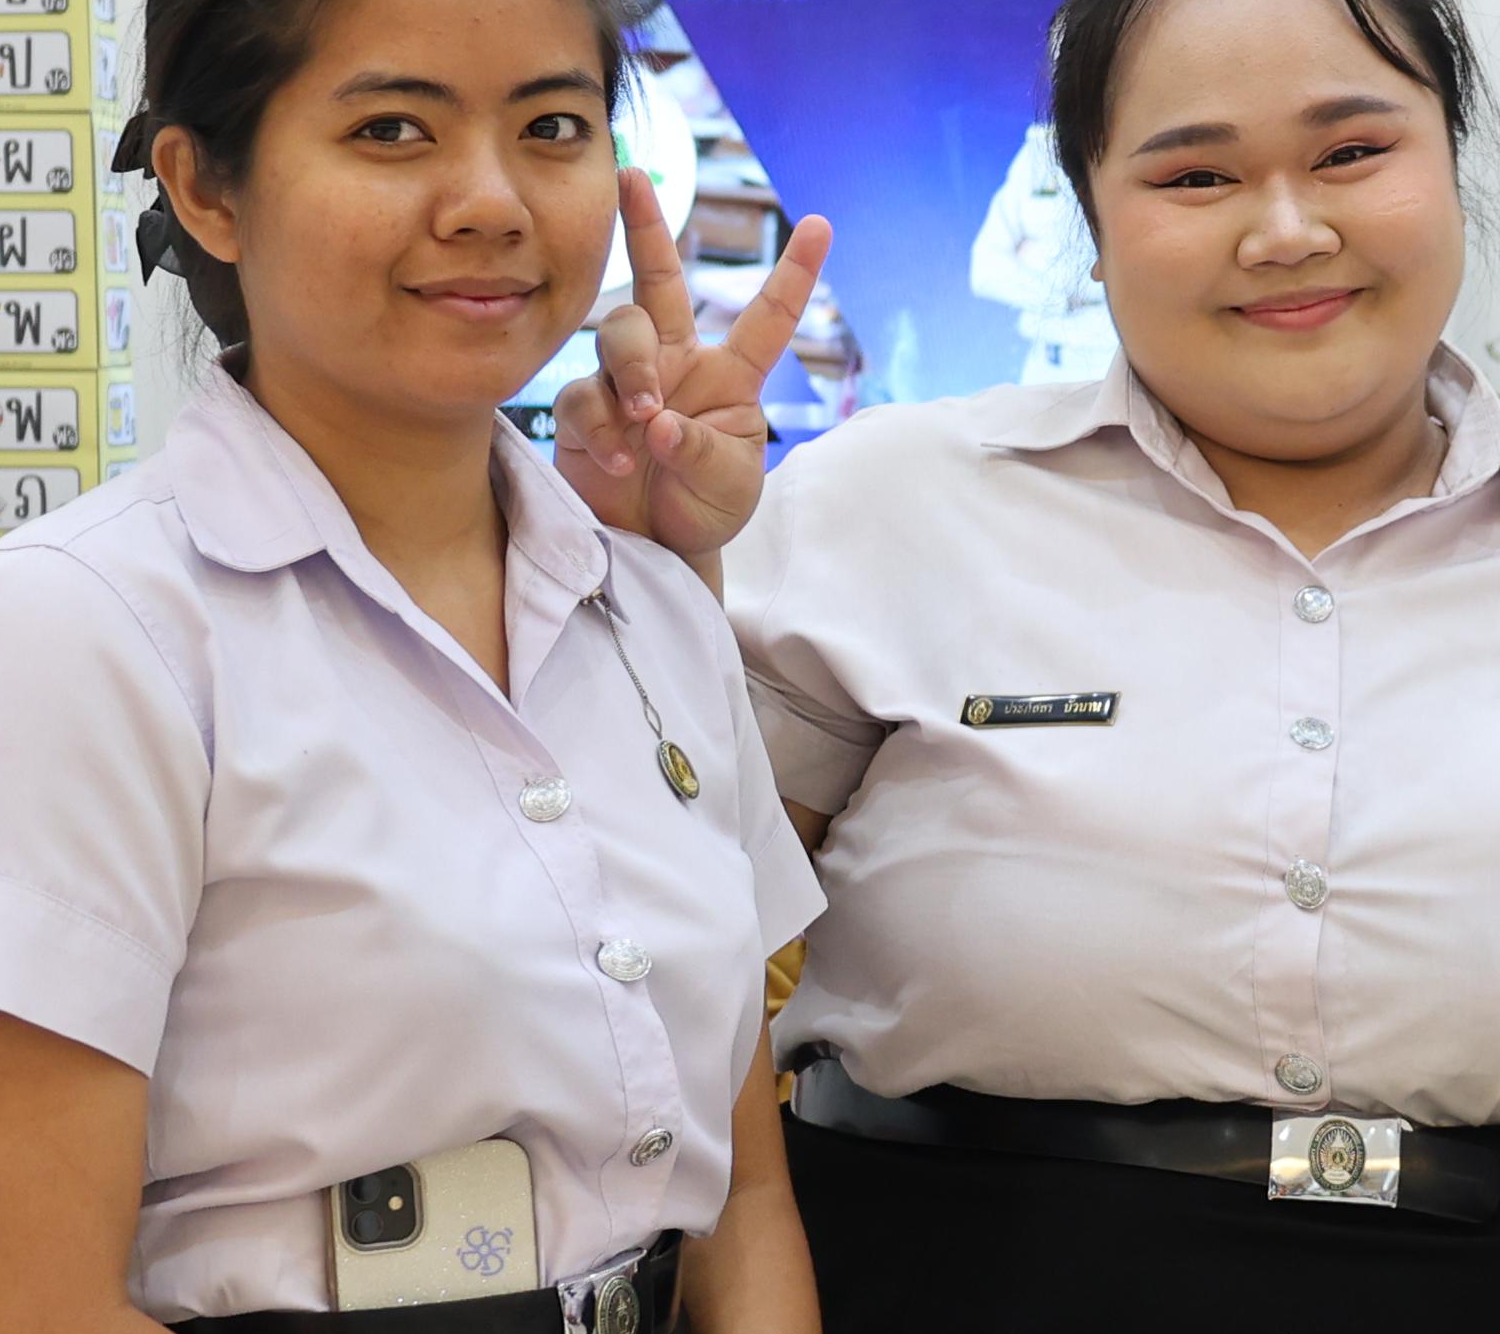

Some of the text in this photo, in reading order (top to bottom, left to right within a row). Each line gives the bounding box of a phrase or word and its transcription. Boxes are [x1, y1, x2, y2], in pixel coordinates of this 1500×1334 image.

[4, 139, 33, 184] ผ
[4, 301, 41, 347] พ
[6, 390, 42, 443] ฟ
